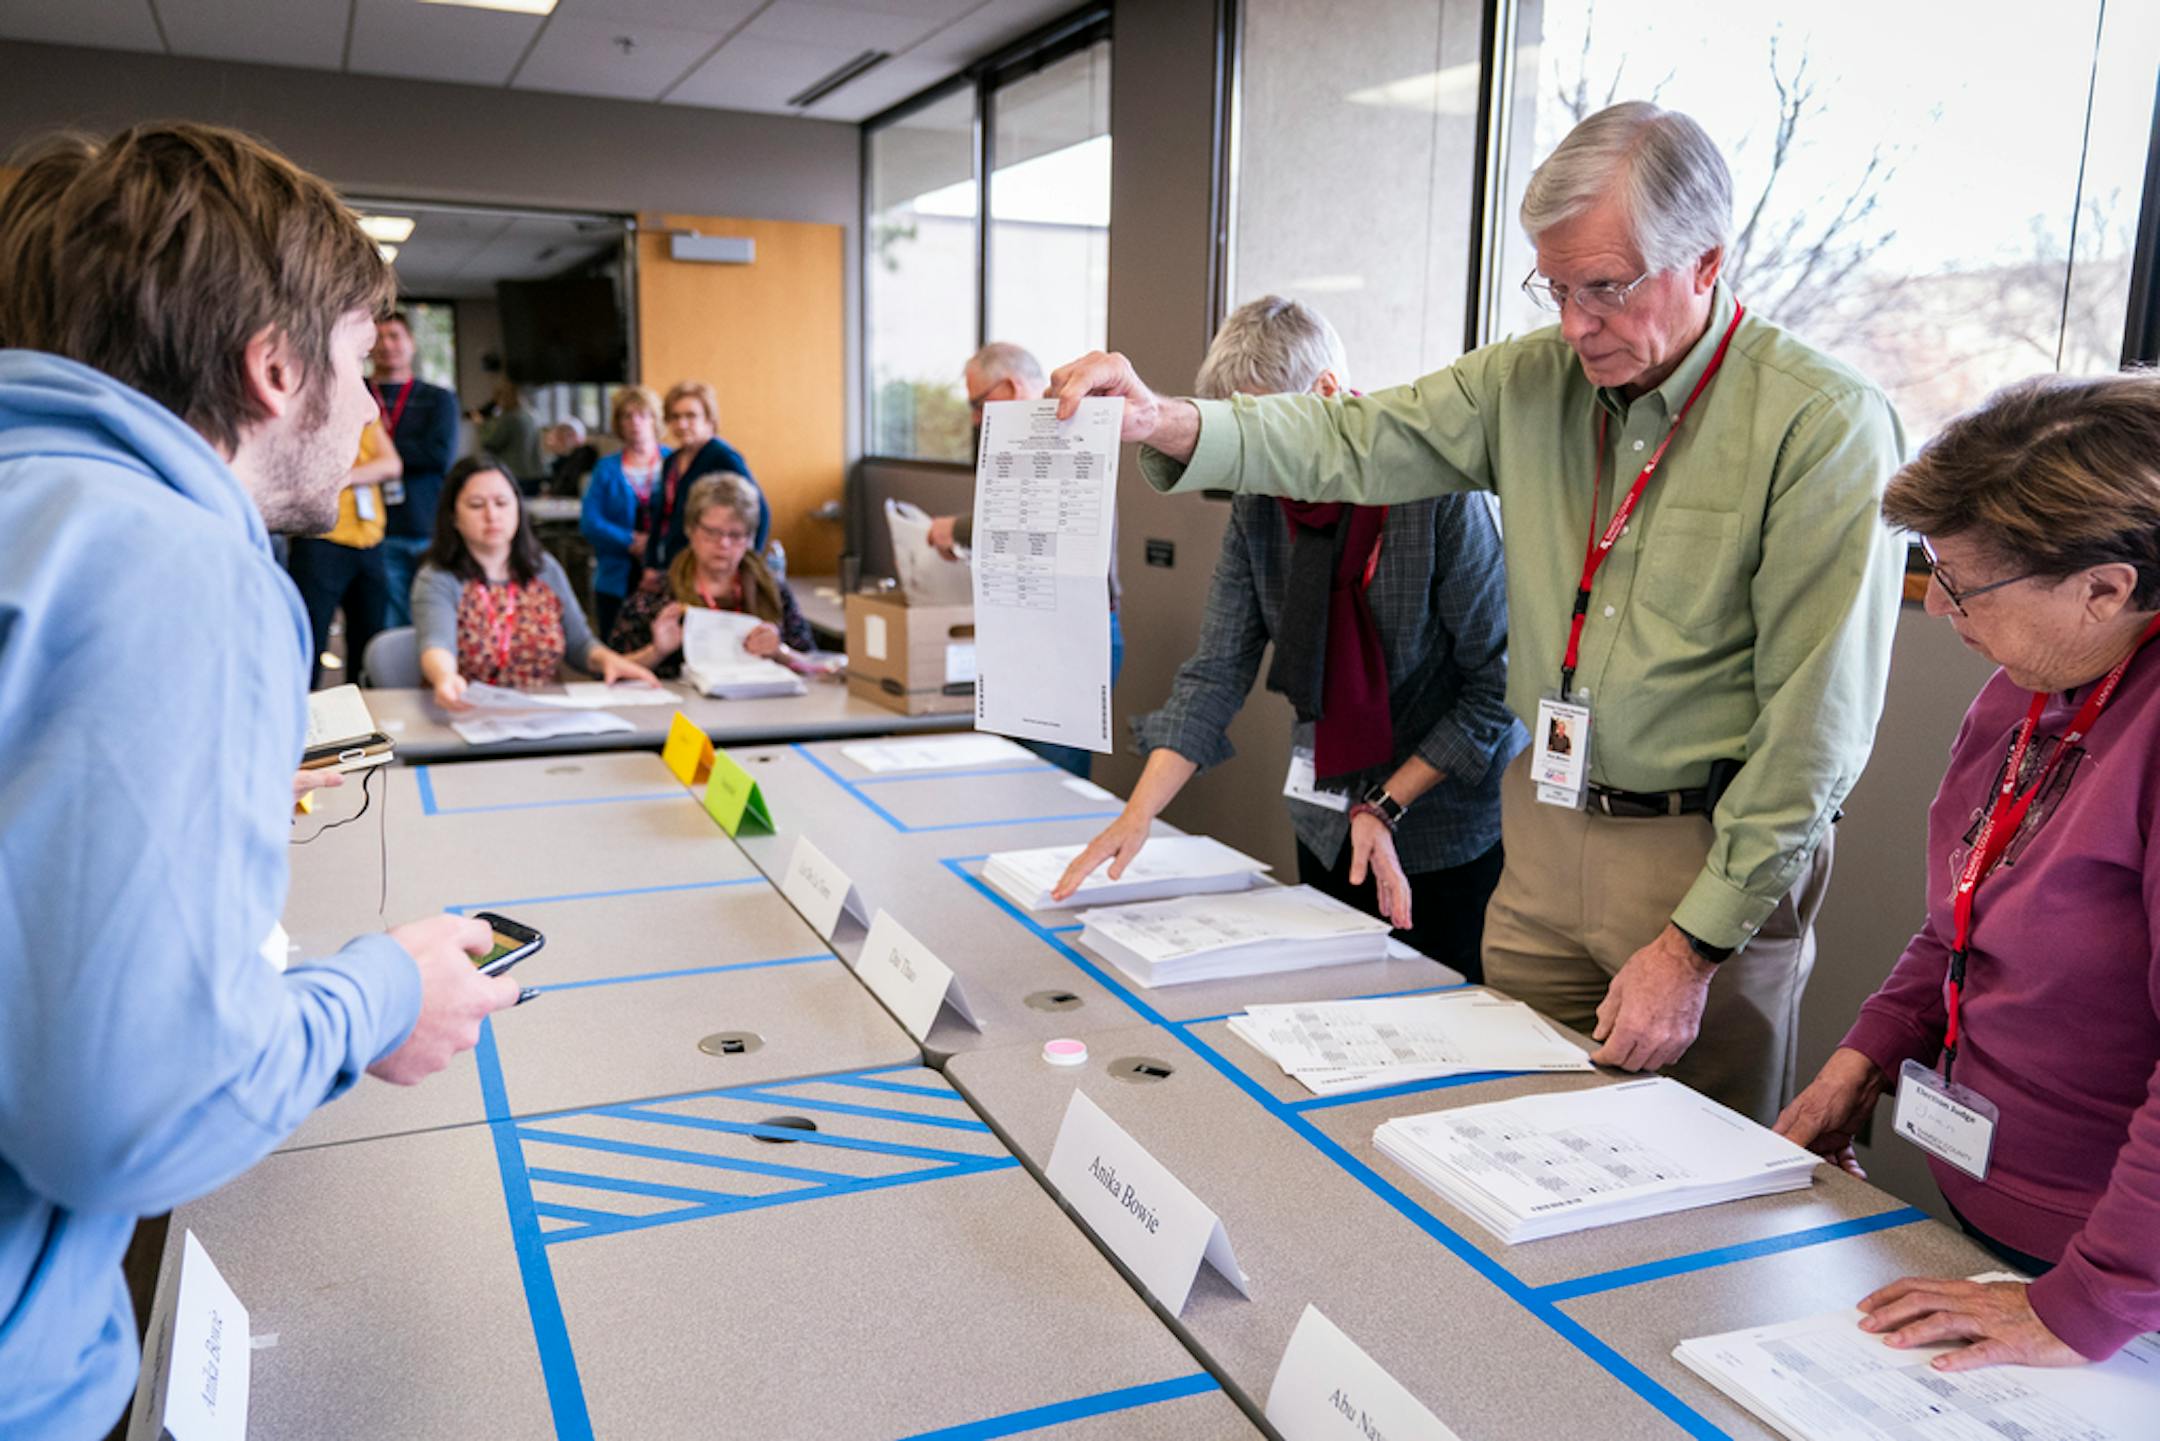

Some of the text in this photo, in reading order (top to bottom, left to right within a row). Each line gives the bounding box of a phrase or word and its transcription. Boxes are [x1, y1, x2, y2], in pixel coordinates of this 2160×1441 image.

[1916, 1086, 1950, 1109] Election
[1951, 1104, 1975, 1123] Judge
[1088, 1156, 1160, 1235] Anika Bowie
[1328, 1388, 1357, 1422] Abu
